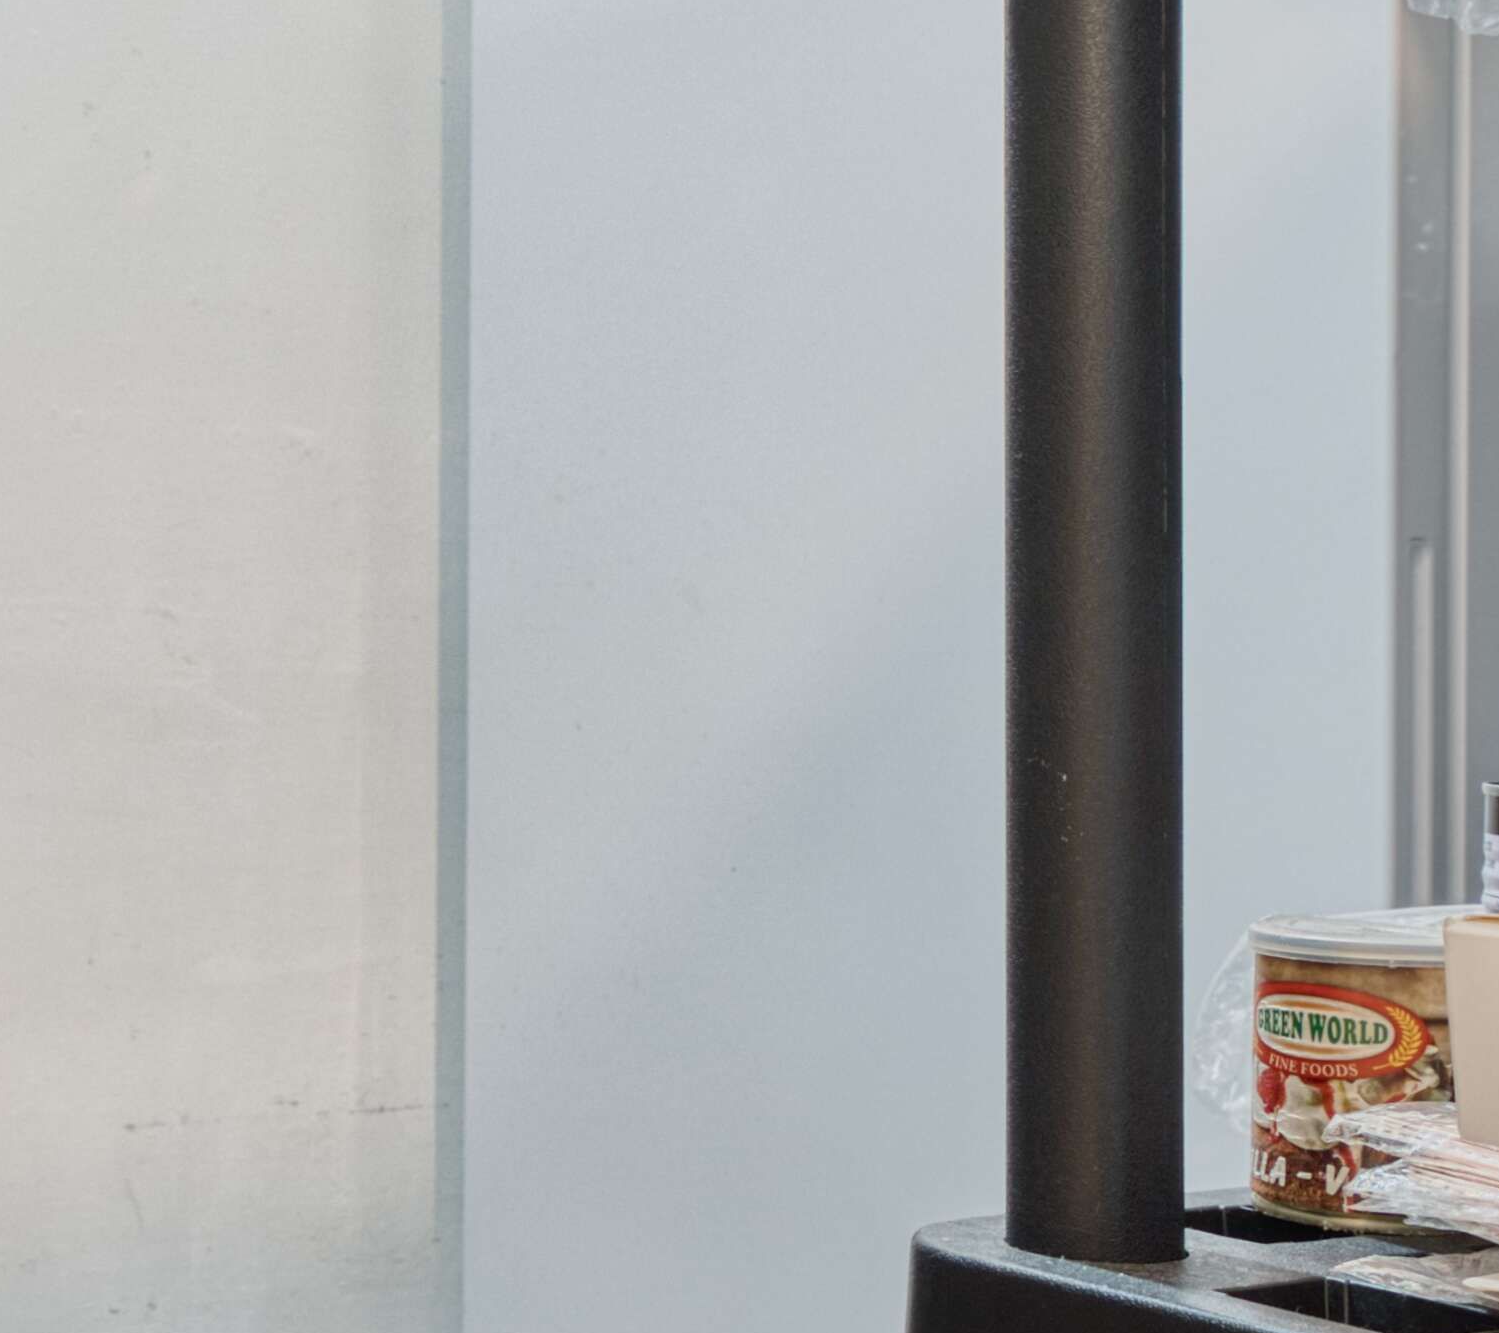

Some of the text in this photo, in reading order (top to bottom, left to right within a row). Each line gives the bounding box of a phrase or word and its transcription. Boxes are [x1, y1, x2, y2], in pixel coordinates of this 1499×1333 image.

[1257, 1007, 1389, 1046] GREEN WORLD
[1268, 1053, 1359, 1078] FINE FOODS
